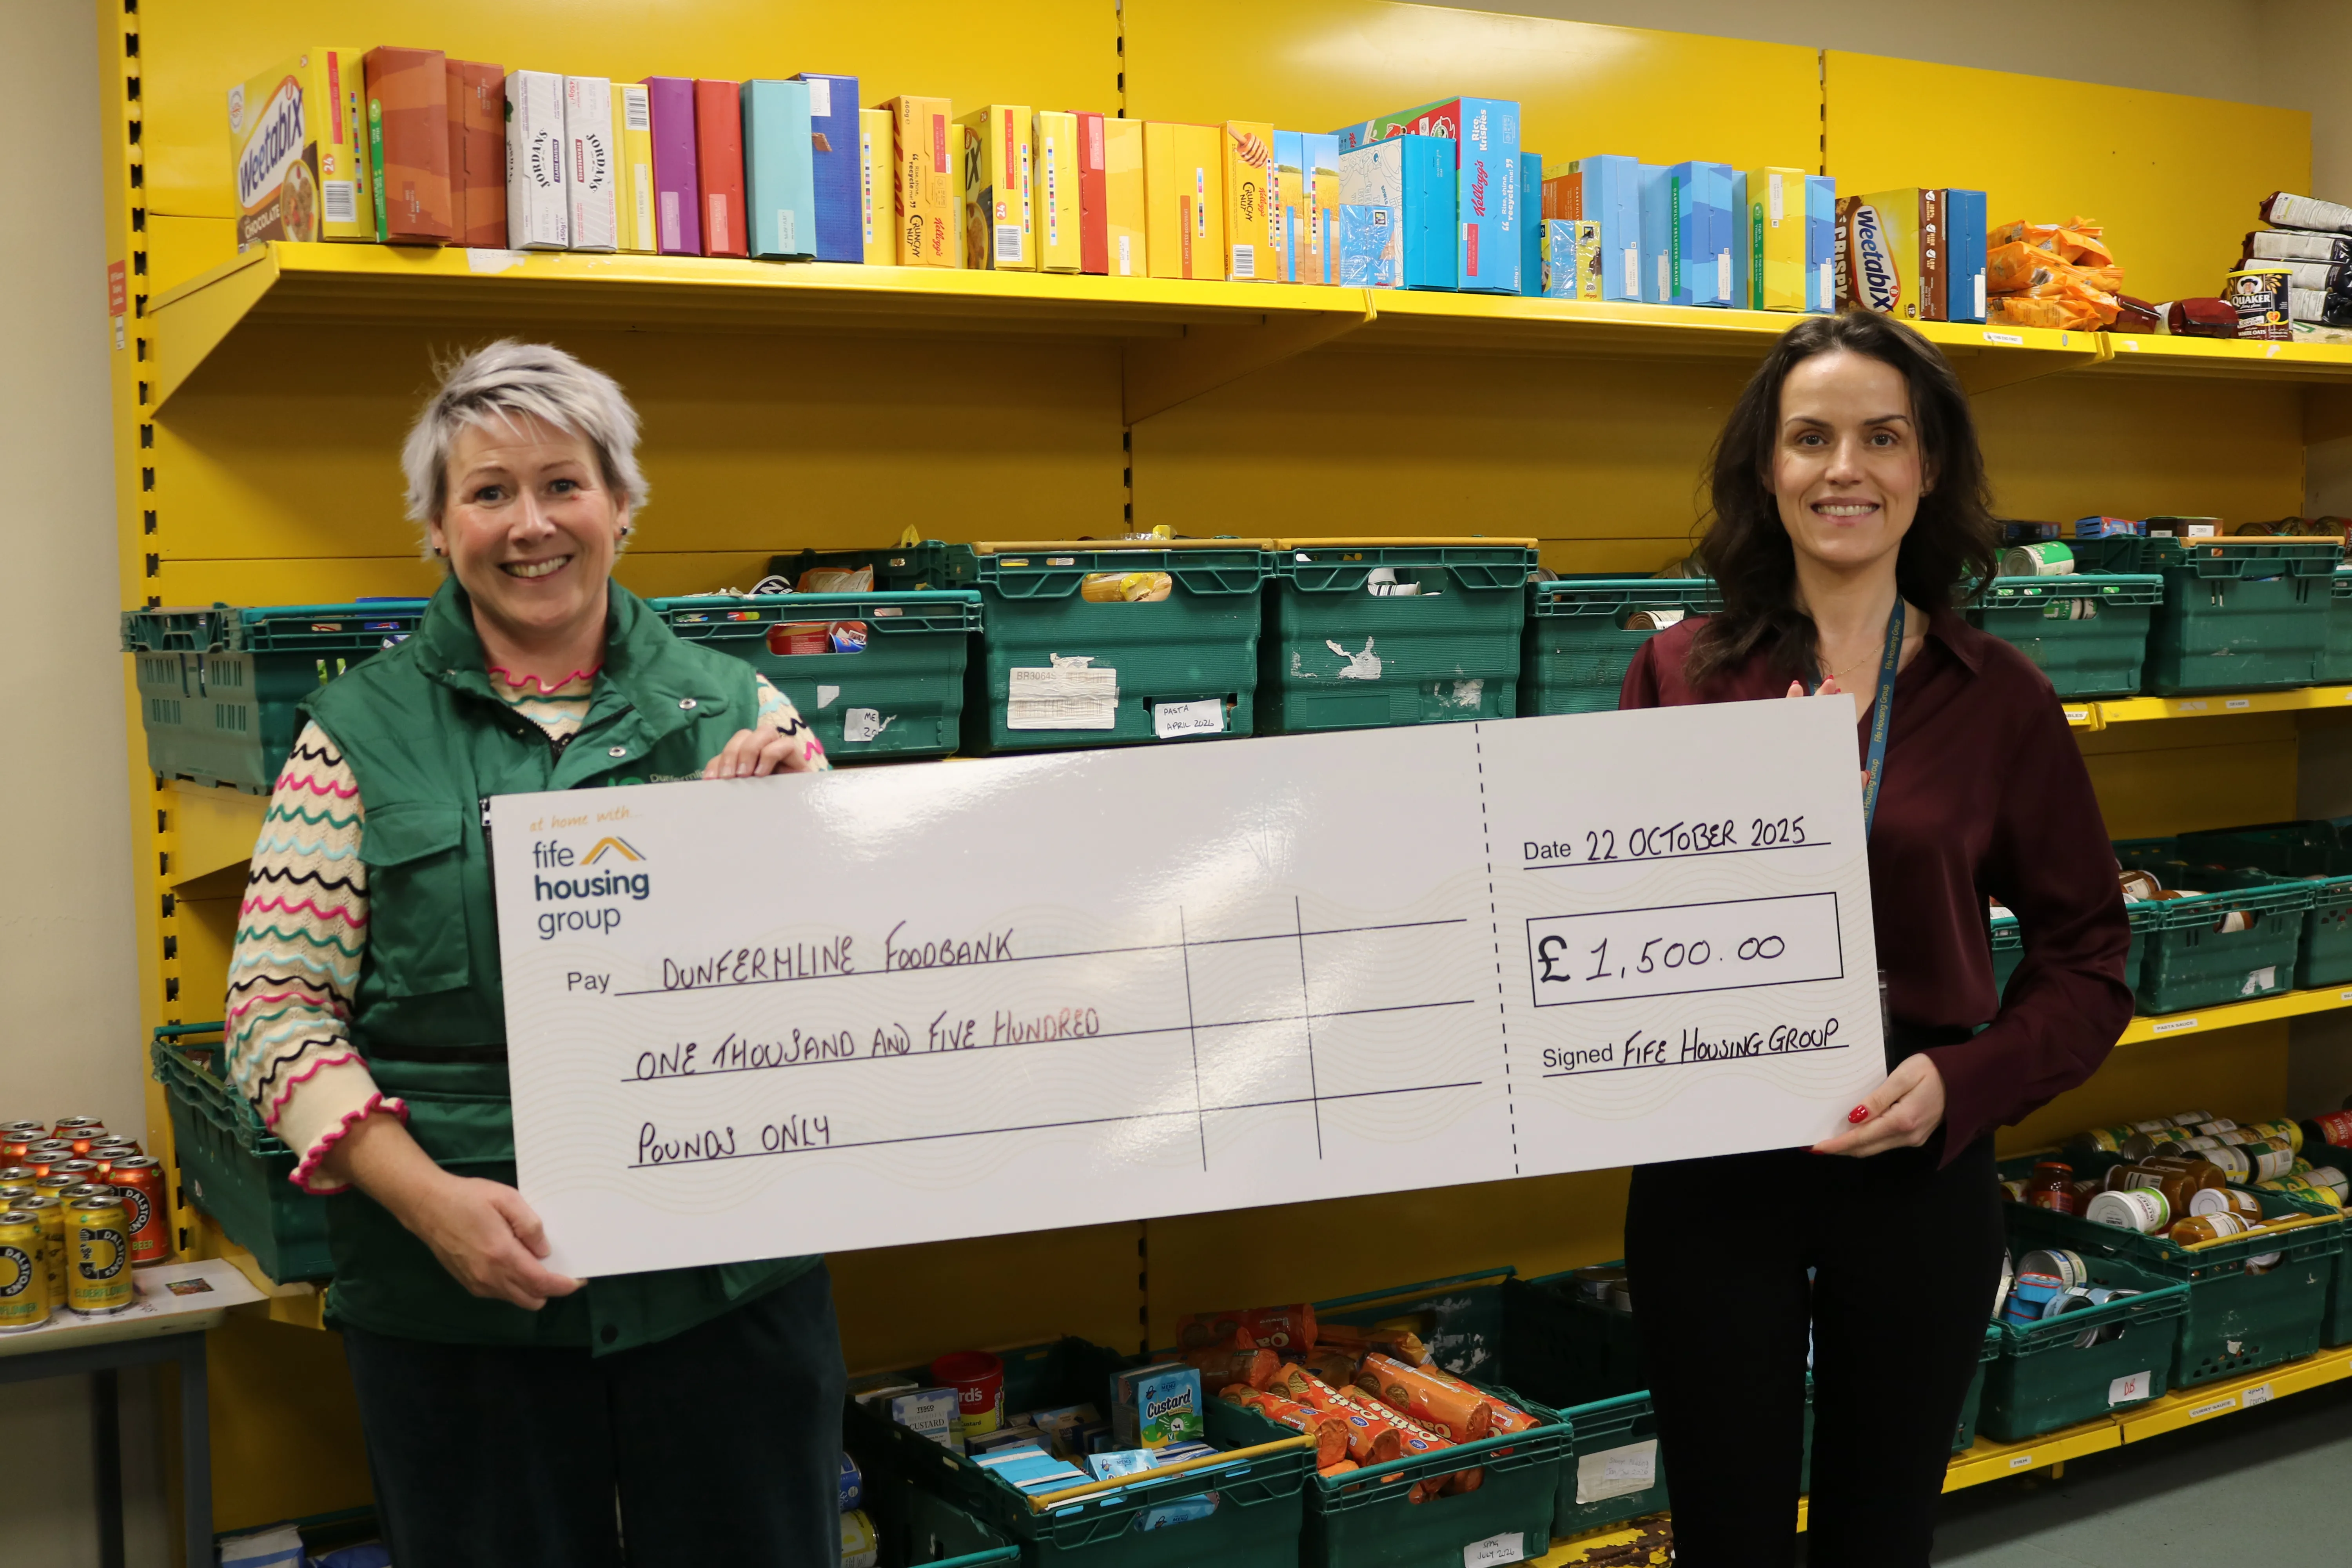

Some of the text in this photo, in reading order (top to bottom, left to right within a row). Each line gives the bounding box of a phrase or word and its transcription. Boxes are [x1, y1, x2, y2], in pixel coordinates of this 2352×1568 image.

[980, 112, 987, 122] 24
[1479, 109, 1488, 151] Krispies
[240, 87, 304, 202] Weetabix
[324, 156, 333, 171] 24
[532, 128, 550, 189] JORDANS
[586, 134, 605, 193] JORDANS
[1243, 181, 1255, 222] CRUNCHY
[1471, 160, 1488, 217] Kellogg's
[245, 204, 280, 238] CHOCOLATE
[997, 204, 1005, 218] 24
[909, 215, 923, 258] CRUNCHY
[933, 217, 944, 256] Kellogg's
[1833, 225, 1847, 300] CRISPY
[1857, 209, 1893, 312] Weetabix
[2232, 294, 2271, 307] QUAKER
[1887, 634, 1898, 659] Housing
[1893, 619, 1901, 635] Group
[1163, 705, 1189, 716] PASTA
[1880, 684, 1890, 704] Group
[1167, 719, 1214, 731] APRIL 2026
[1877, 705, 1887, 731] Housing
[1864, 759, 1880, 808] Housing Group
[530, 819, 543, 832] at
[551, 815, 588, 829] home
[1524, 816, 1806, 861] Date 22 OCTOBER 2025
[533, 840, 574, 868] fife
[534, 869, 650, 901] housing
[538, 908, 621, 940] group
[567, 920, 1014, 994] Pay DUNFERMLINE FOODBANK
[1537, 935, 1785, 983] £ 1,500.00
[637, 1007, 1100, 1080] ONE THOUSAND AND FIVE HUNDRED
[1543, 1018, 1839, 1071] Signed FIFE HOUSING GROUP
[639, 1114, 830, 1163] POUNDS ONLY
[132, 1241, 154, 1250] BEER
[1147, 1388, 1192, 1418] Custard
[1311, 1379, 1380, 1421] Oaties
[2192, 1400, 2232, 1416] CURRY SAUCE
[909, 1419, 944, 1430] CUSTARD
[1368, 1402, 1439, 1442] Oaties
[1477, 1548, 1515, 1560] JULY 2026
